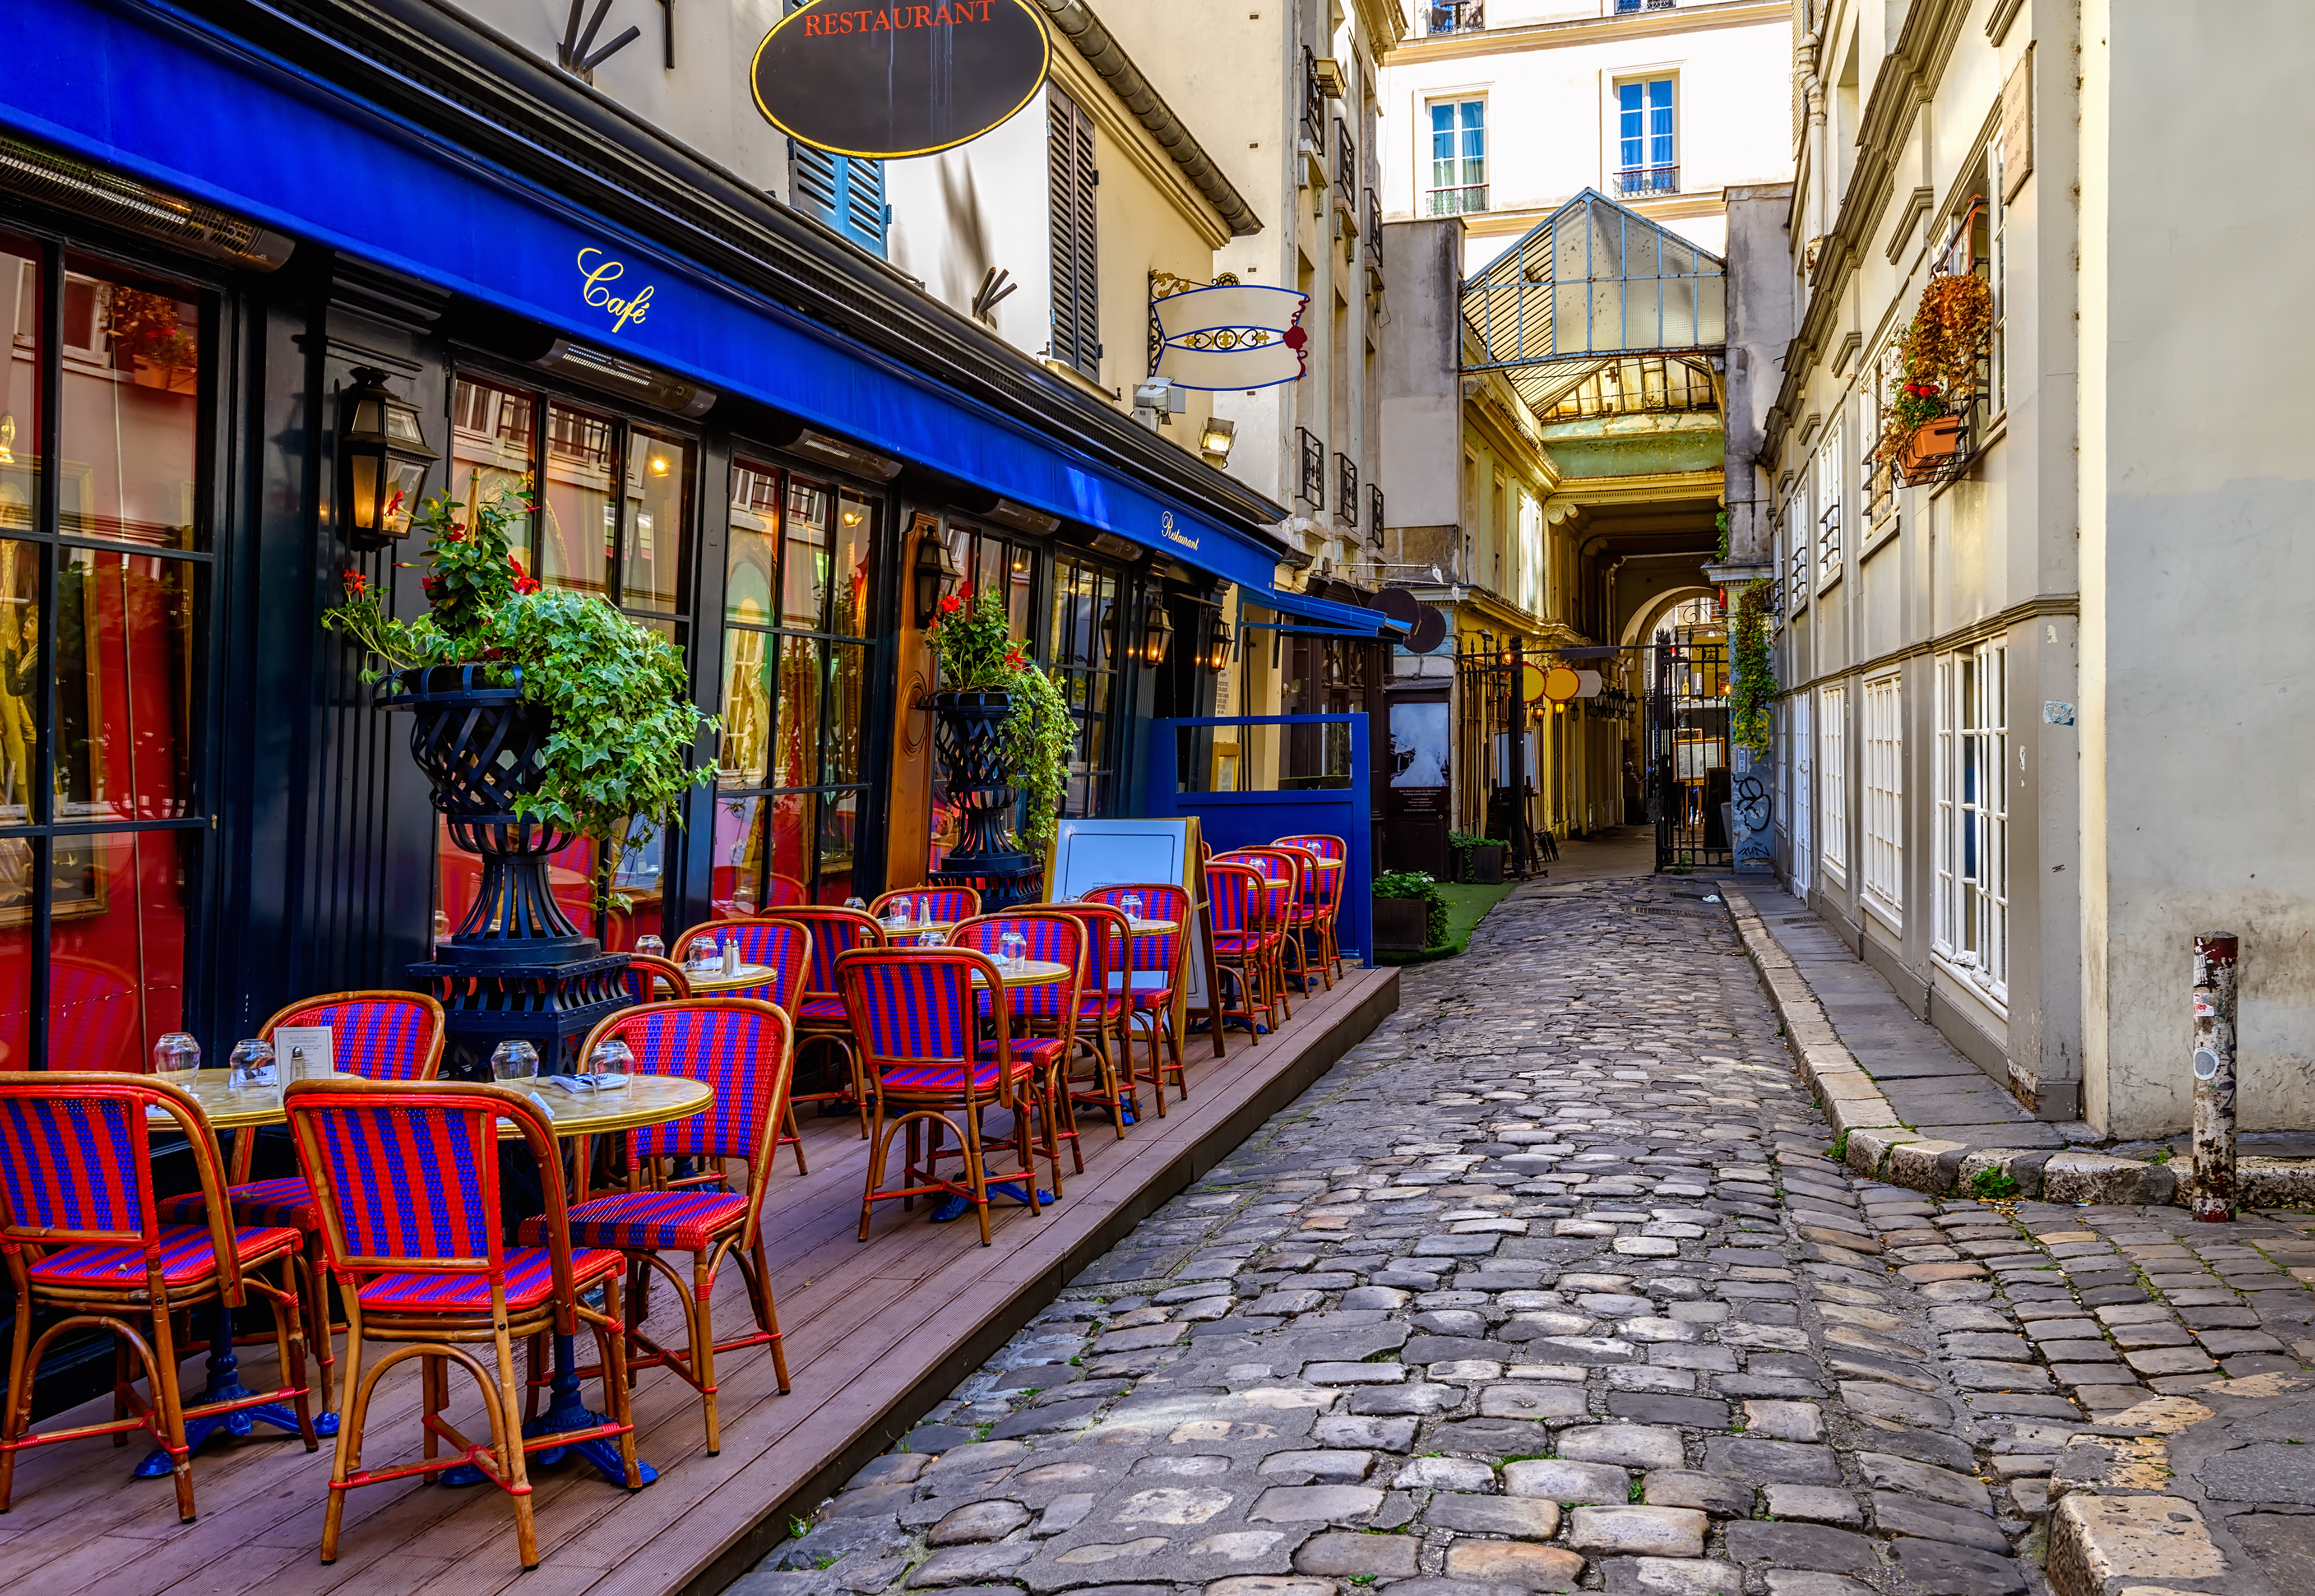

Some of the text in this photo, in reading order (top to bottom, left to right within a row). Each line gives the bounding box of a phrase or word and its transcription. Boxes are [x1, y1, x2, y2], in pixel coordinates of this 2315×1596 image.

[804, 0, 995, 37] RESTAURANT
[577, 248, 654, 333] Café
[1162, 511, 1199, 551] Restaurant
